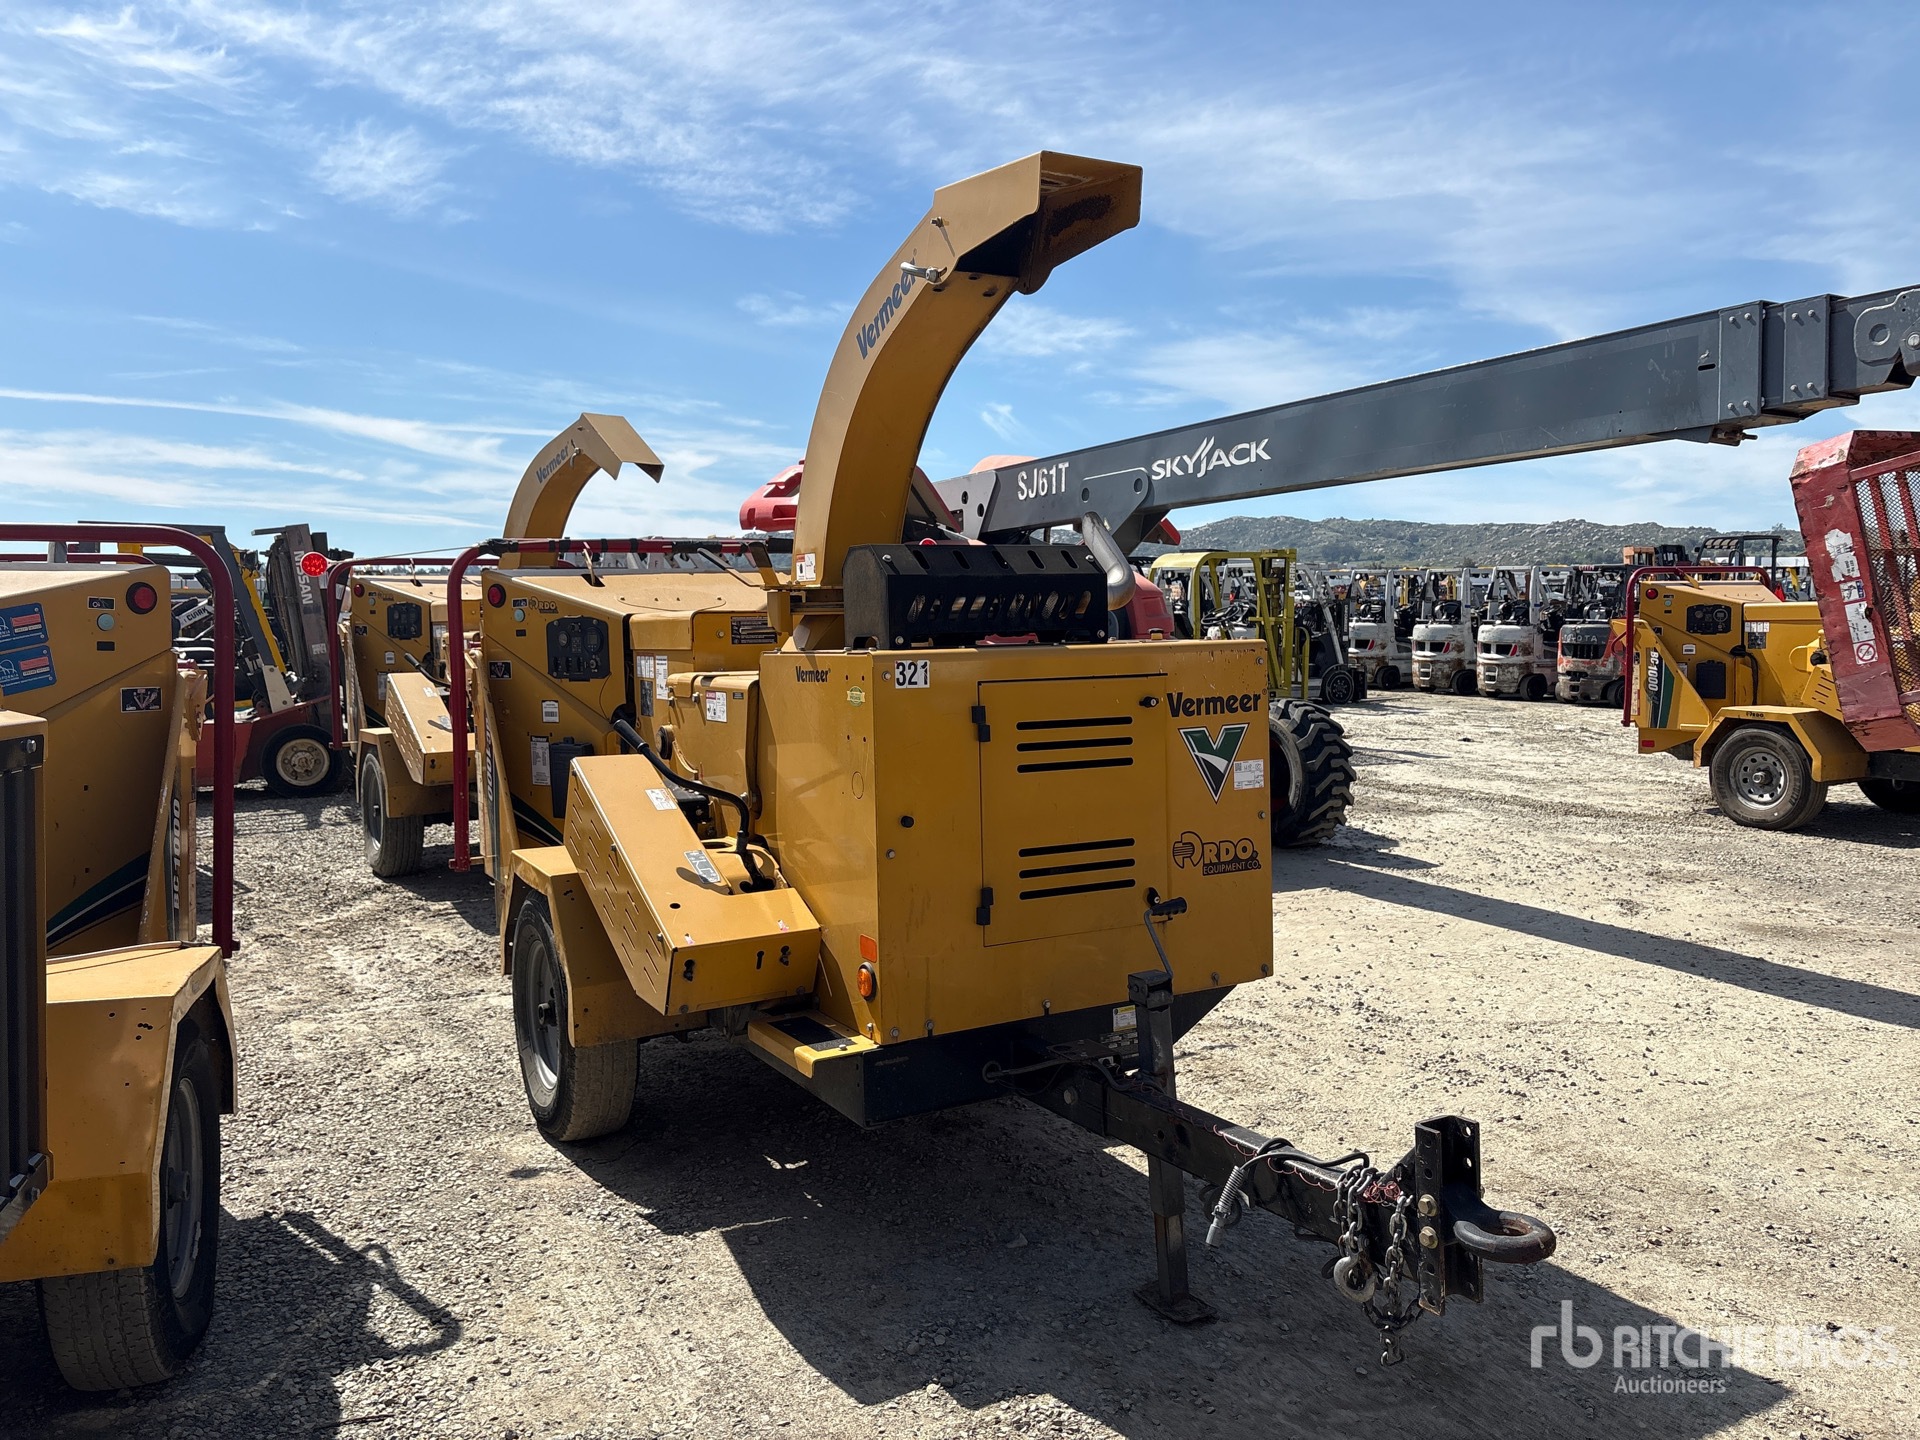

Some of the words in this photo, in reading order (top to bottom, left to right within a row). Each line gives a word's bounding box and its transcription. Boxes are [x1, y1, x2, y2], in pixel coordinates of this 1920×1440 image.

[856, 256, 916, 360] Vermeer
[536, 445, 569, 484] Vermeer
[1151, 436, 1272, 481] SKYJACK
[1017, 461, 1071, 502] SJ61T
[1288, 561, 1296, 588] CLARK
[795, 665, 831, 683] Vermeer
[895, 660, 930, 688] 321
[1166, 690, 1262, 718] Vermeer
[1203, 861, 1246, 875] EQUIPMENT
